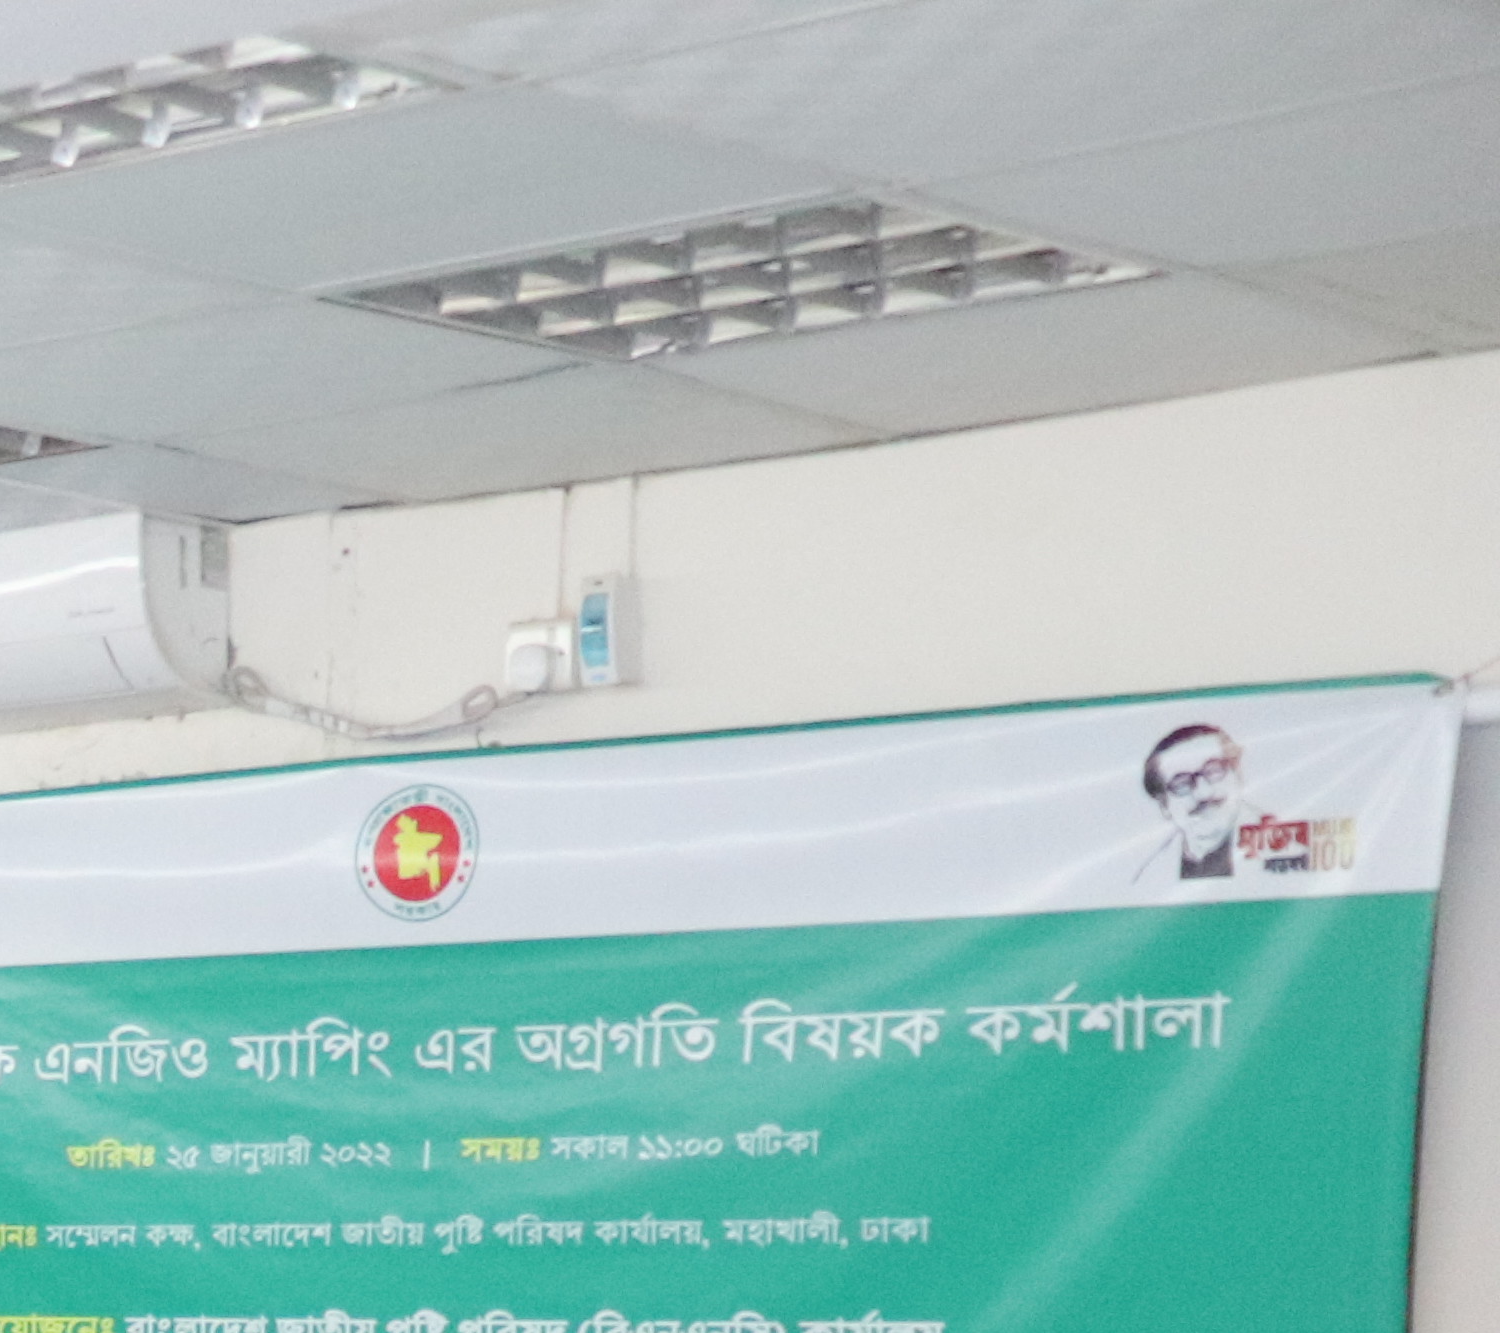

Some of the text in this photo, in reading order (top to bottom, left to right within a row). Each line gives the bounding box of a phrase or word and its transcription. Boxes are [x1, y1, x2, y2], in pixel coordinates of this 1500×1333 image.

[34, 1023, 208, 1083] এনজিও
[229, 1016, 392, 1082] ম্যাপিং
[415, 1027, 496, 1073] এর
[515, 1002, 721, 1074] অগ্রগতি
[737, 998, 946, 1064] বিষয়ক
[966, 982, 1231, 1055] কর্মশালা
[167, 1145, 201, 1169] ২৫
[207, 1135, 312, 1174] জানুয়ারী
[320, 1142, 392, 1167] ২০২২
[551, 1135, 629, 1160] সকাল
[636, 1135, 723, 1161] ১১:০০
[734, 1122, 820, 1156] ঘটিকা
[46, 1223, 138, 1248] সম্মেলন
[145, 1224, 202, 1250] কক্ষ,
[212, 1222, 332, 1247] বাংলাদেশ
[341, 1213, 425, 1245] জাতীয়
[433, 1213, 485, 1254] পুষ্টি
[492, 1213, 584, 1244] পরিষদ
[594, 1212, 710, 1249] কার্যালয়,
[722, 1209, 848, 1247] মহাখালী,
[860, 1216, 930, 1242] ঢাকা
